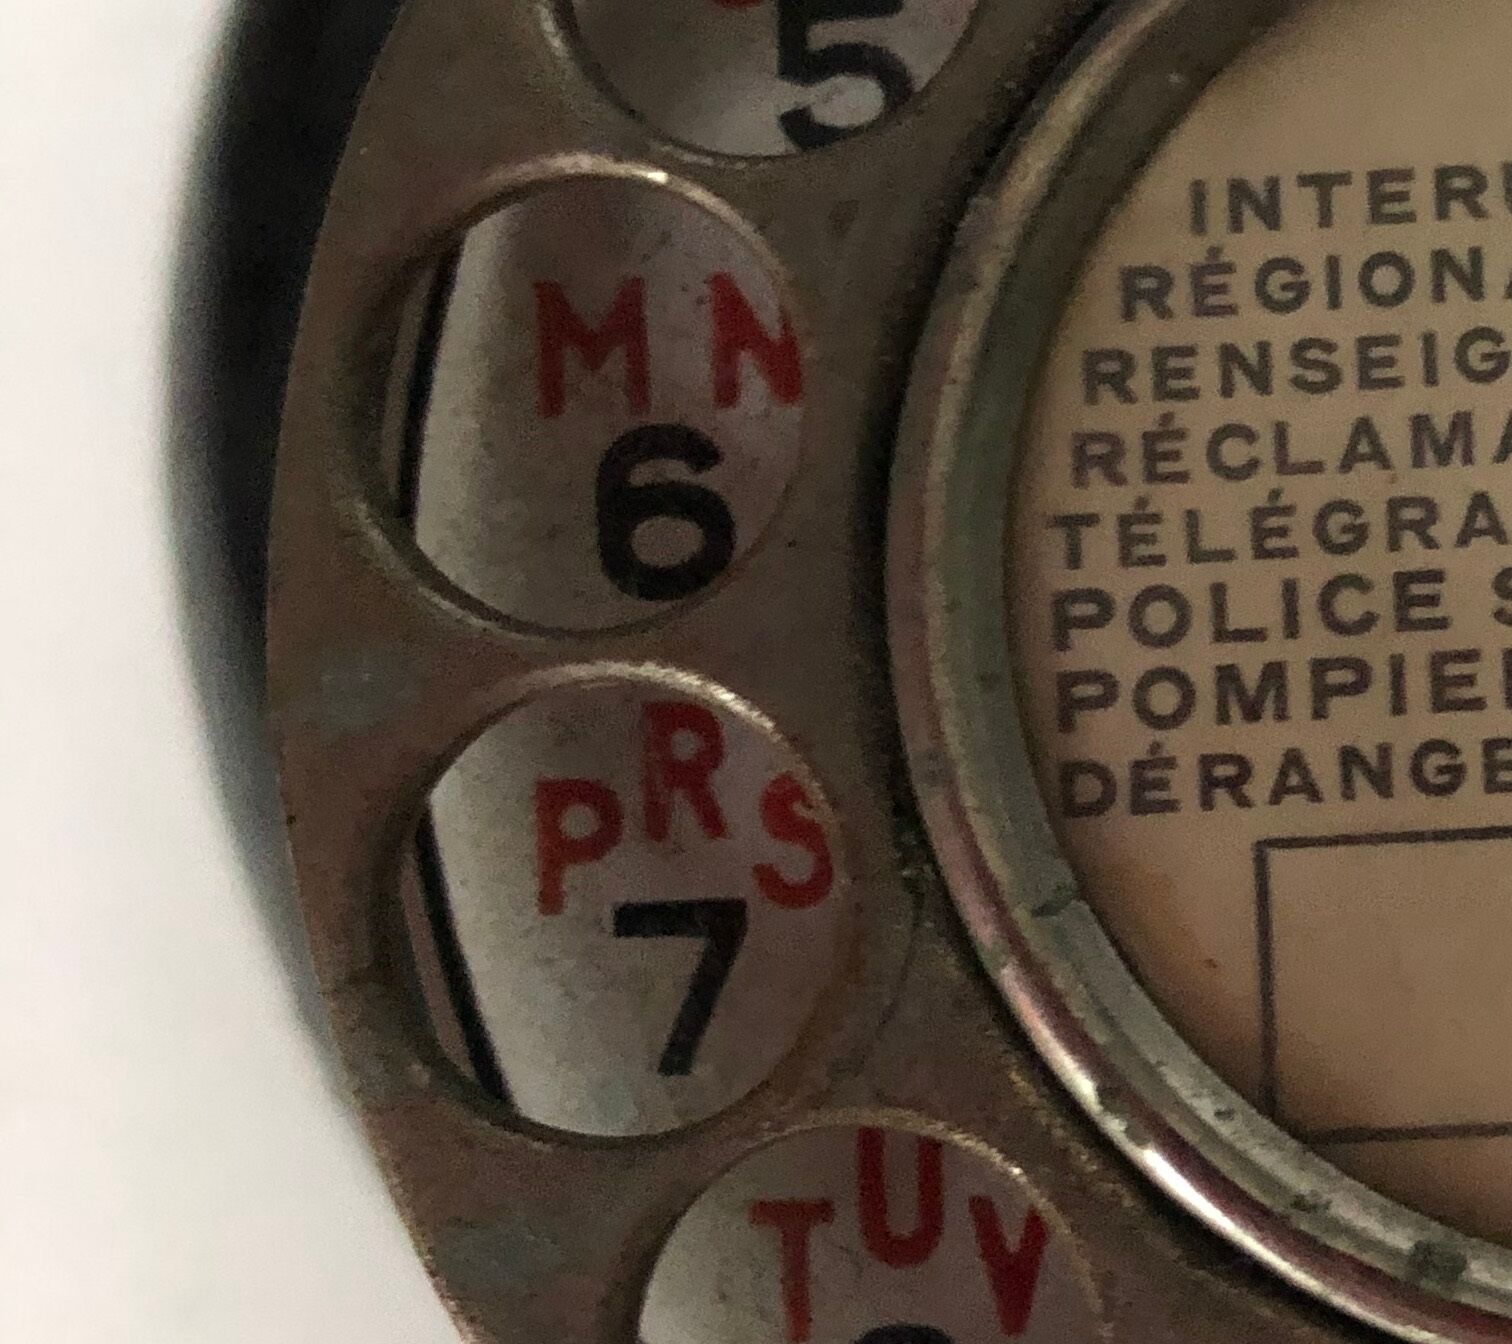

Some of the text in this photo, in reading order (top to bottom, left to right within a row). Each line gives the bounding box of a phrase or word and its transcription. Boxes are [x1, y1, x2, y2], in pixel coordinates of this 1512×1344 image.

[596, 422, 736, 603] 6
[1050, 568, 1450, 652] POLICE
[534, 700, 835, 917] PRS
[613, 897, 748, 1077] 7
[748, 1127, 1048, 1344] TUV
